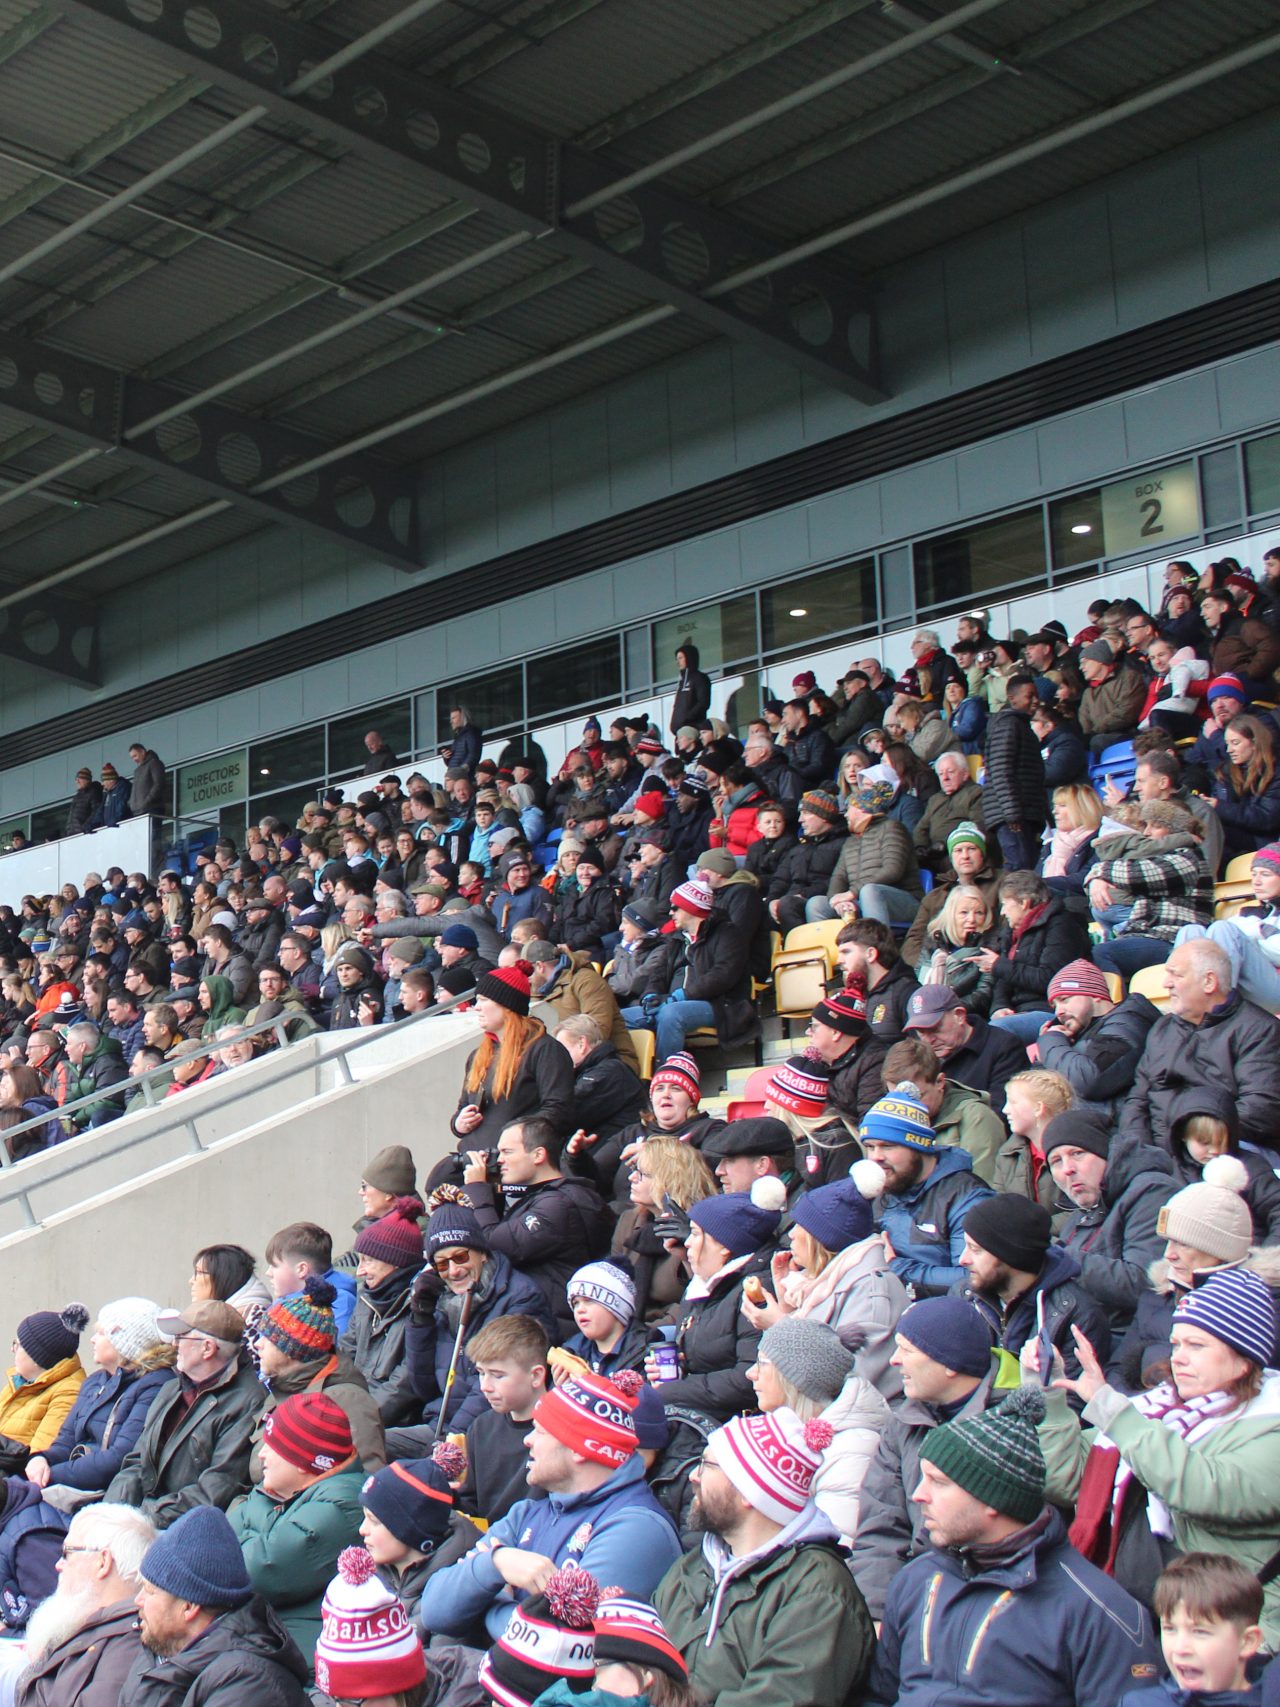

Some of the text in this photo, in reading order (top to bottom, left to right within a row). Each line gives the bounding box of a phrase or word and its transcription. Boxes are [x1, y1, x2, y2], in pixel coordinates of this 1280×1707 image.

[1135, 480, 1163, 498] BOX
[1140, 498, 1164, 537] 2
[187, 762, 240, 790] DIRECTORS
[193, 781, 234, 803] LOUNGE
[778, 1094, 801, 1109] RFC
[439, 1234, 464, 1244] RALLY
[570, 1283, 616, 1306] AND
[507, 1618, 540, 1648] gin
[570, 1642, 594, 1660] no
